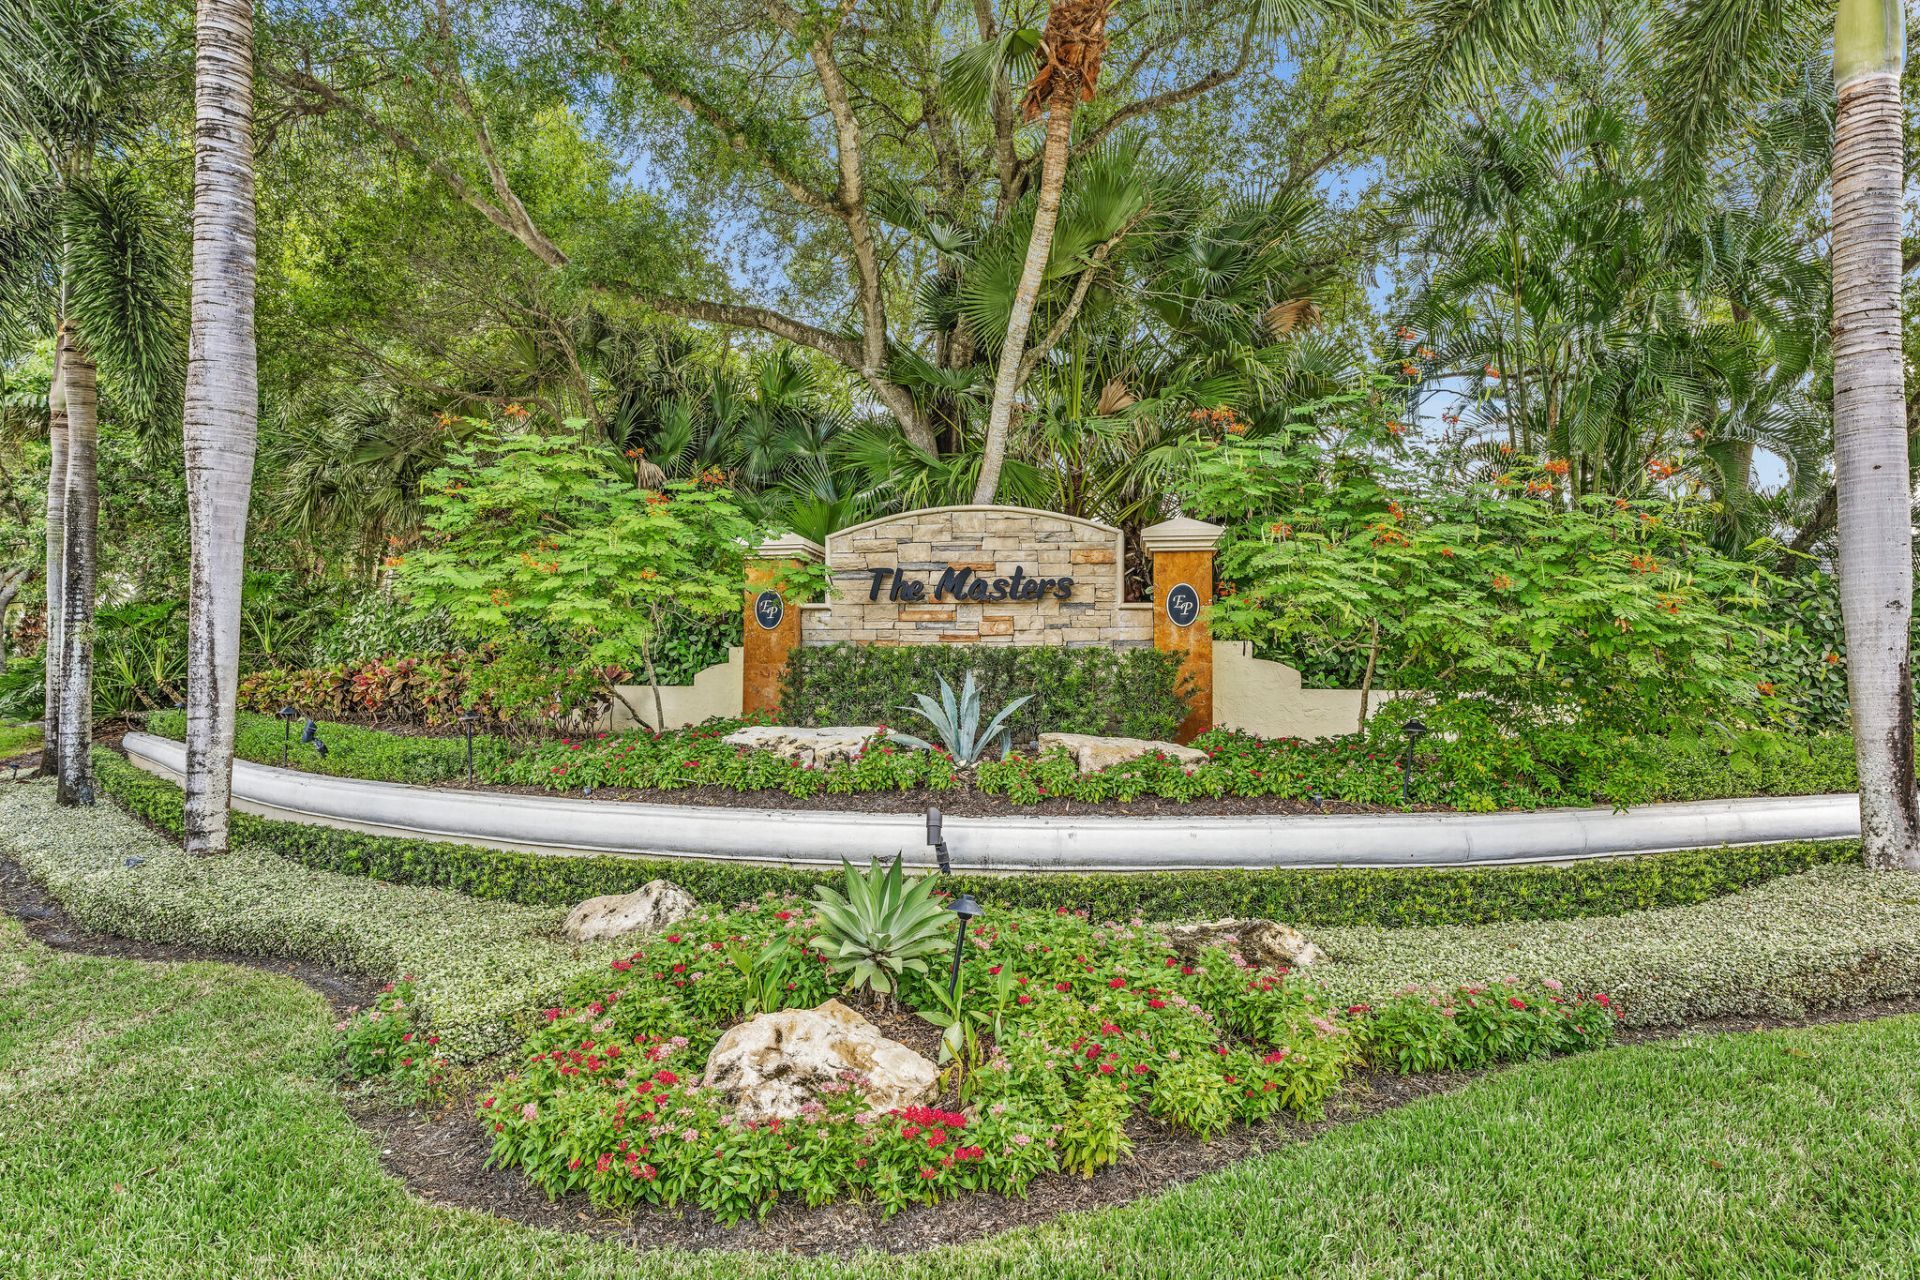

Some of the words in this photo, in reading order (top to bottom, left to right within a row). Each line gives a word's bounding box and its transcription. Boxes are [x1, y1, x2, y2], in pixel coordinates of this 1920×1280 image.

[868, 567, 925, 602] The
[934, 565, 1074, 602] Masters
[1172, 594, 1193, 615] EP
